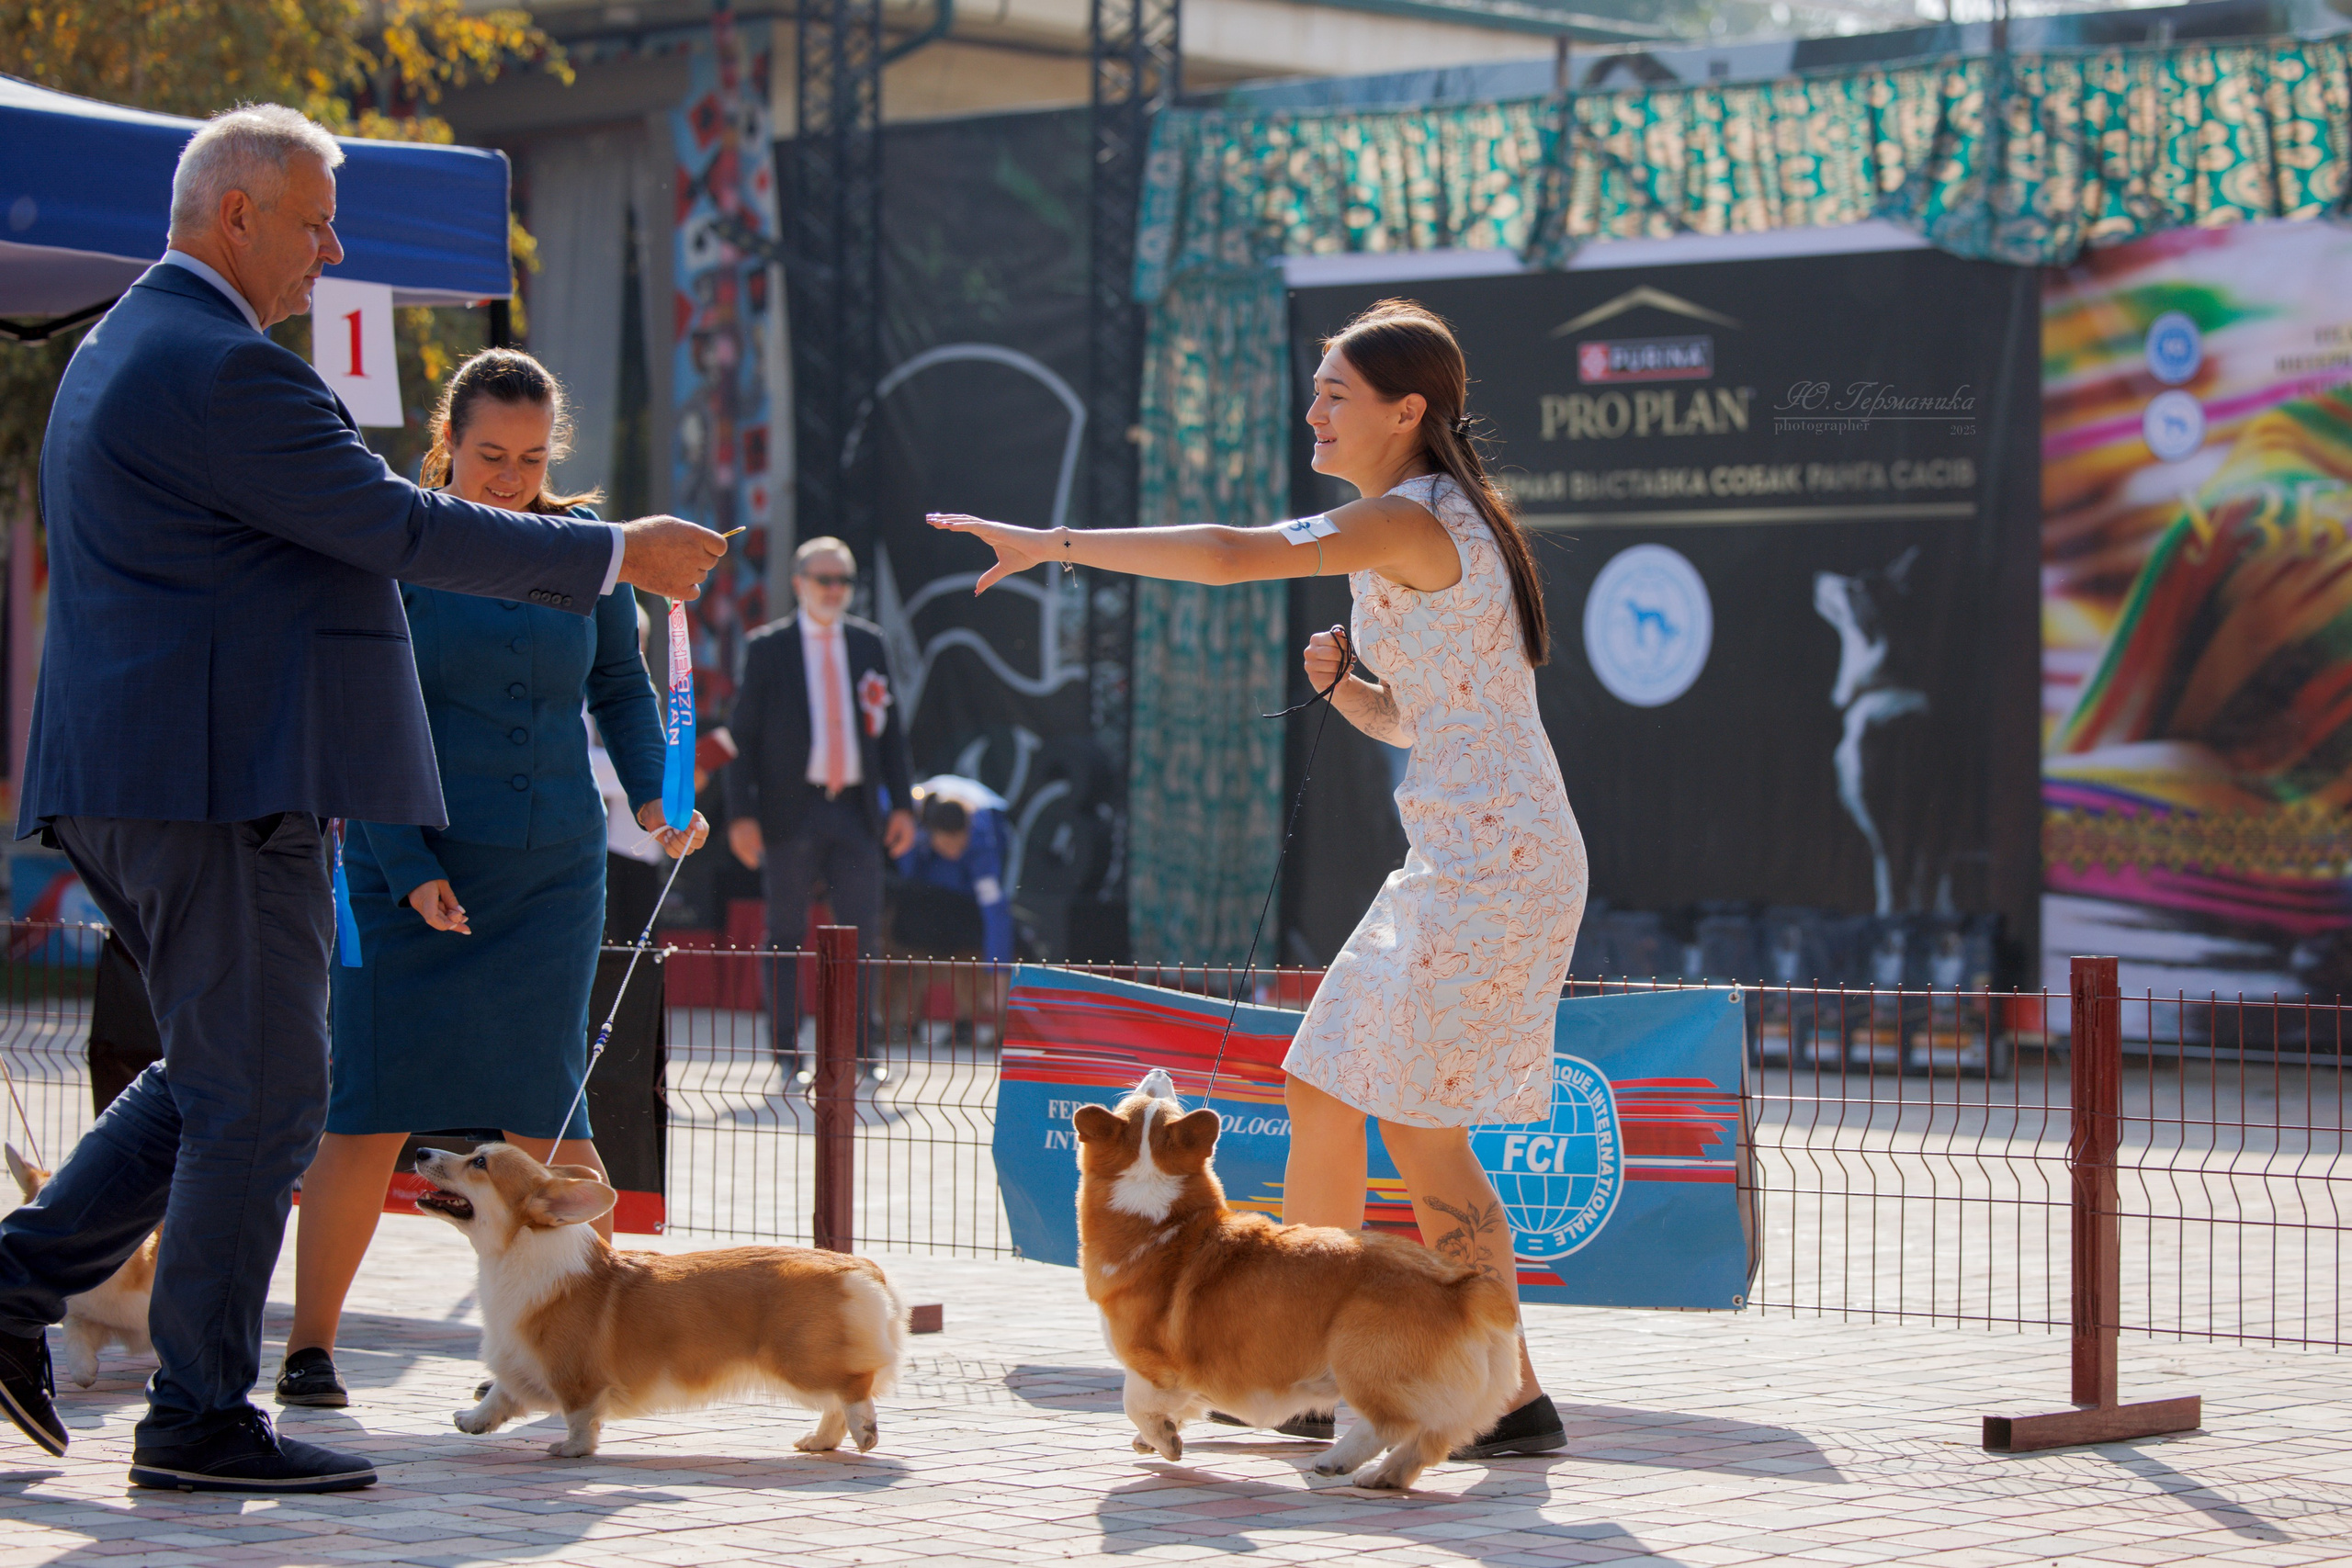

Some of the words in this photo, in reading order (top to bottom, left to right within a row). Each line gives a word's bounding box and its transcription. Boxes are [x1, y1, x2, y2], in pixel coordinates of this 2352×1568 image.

[342, 308, 371, 379] 1
[1610, 343, 1705, 370] PURINA
[1502, 1134, 1568, 1173] FCI
[1553, 1087, 1614, 1247] INTERNATIONALE
